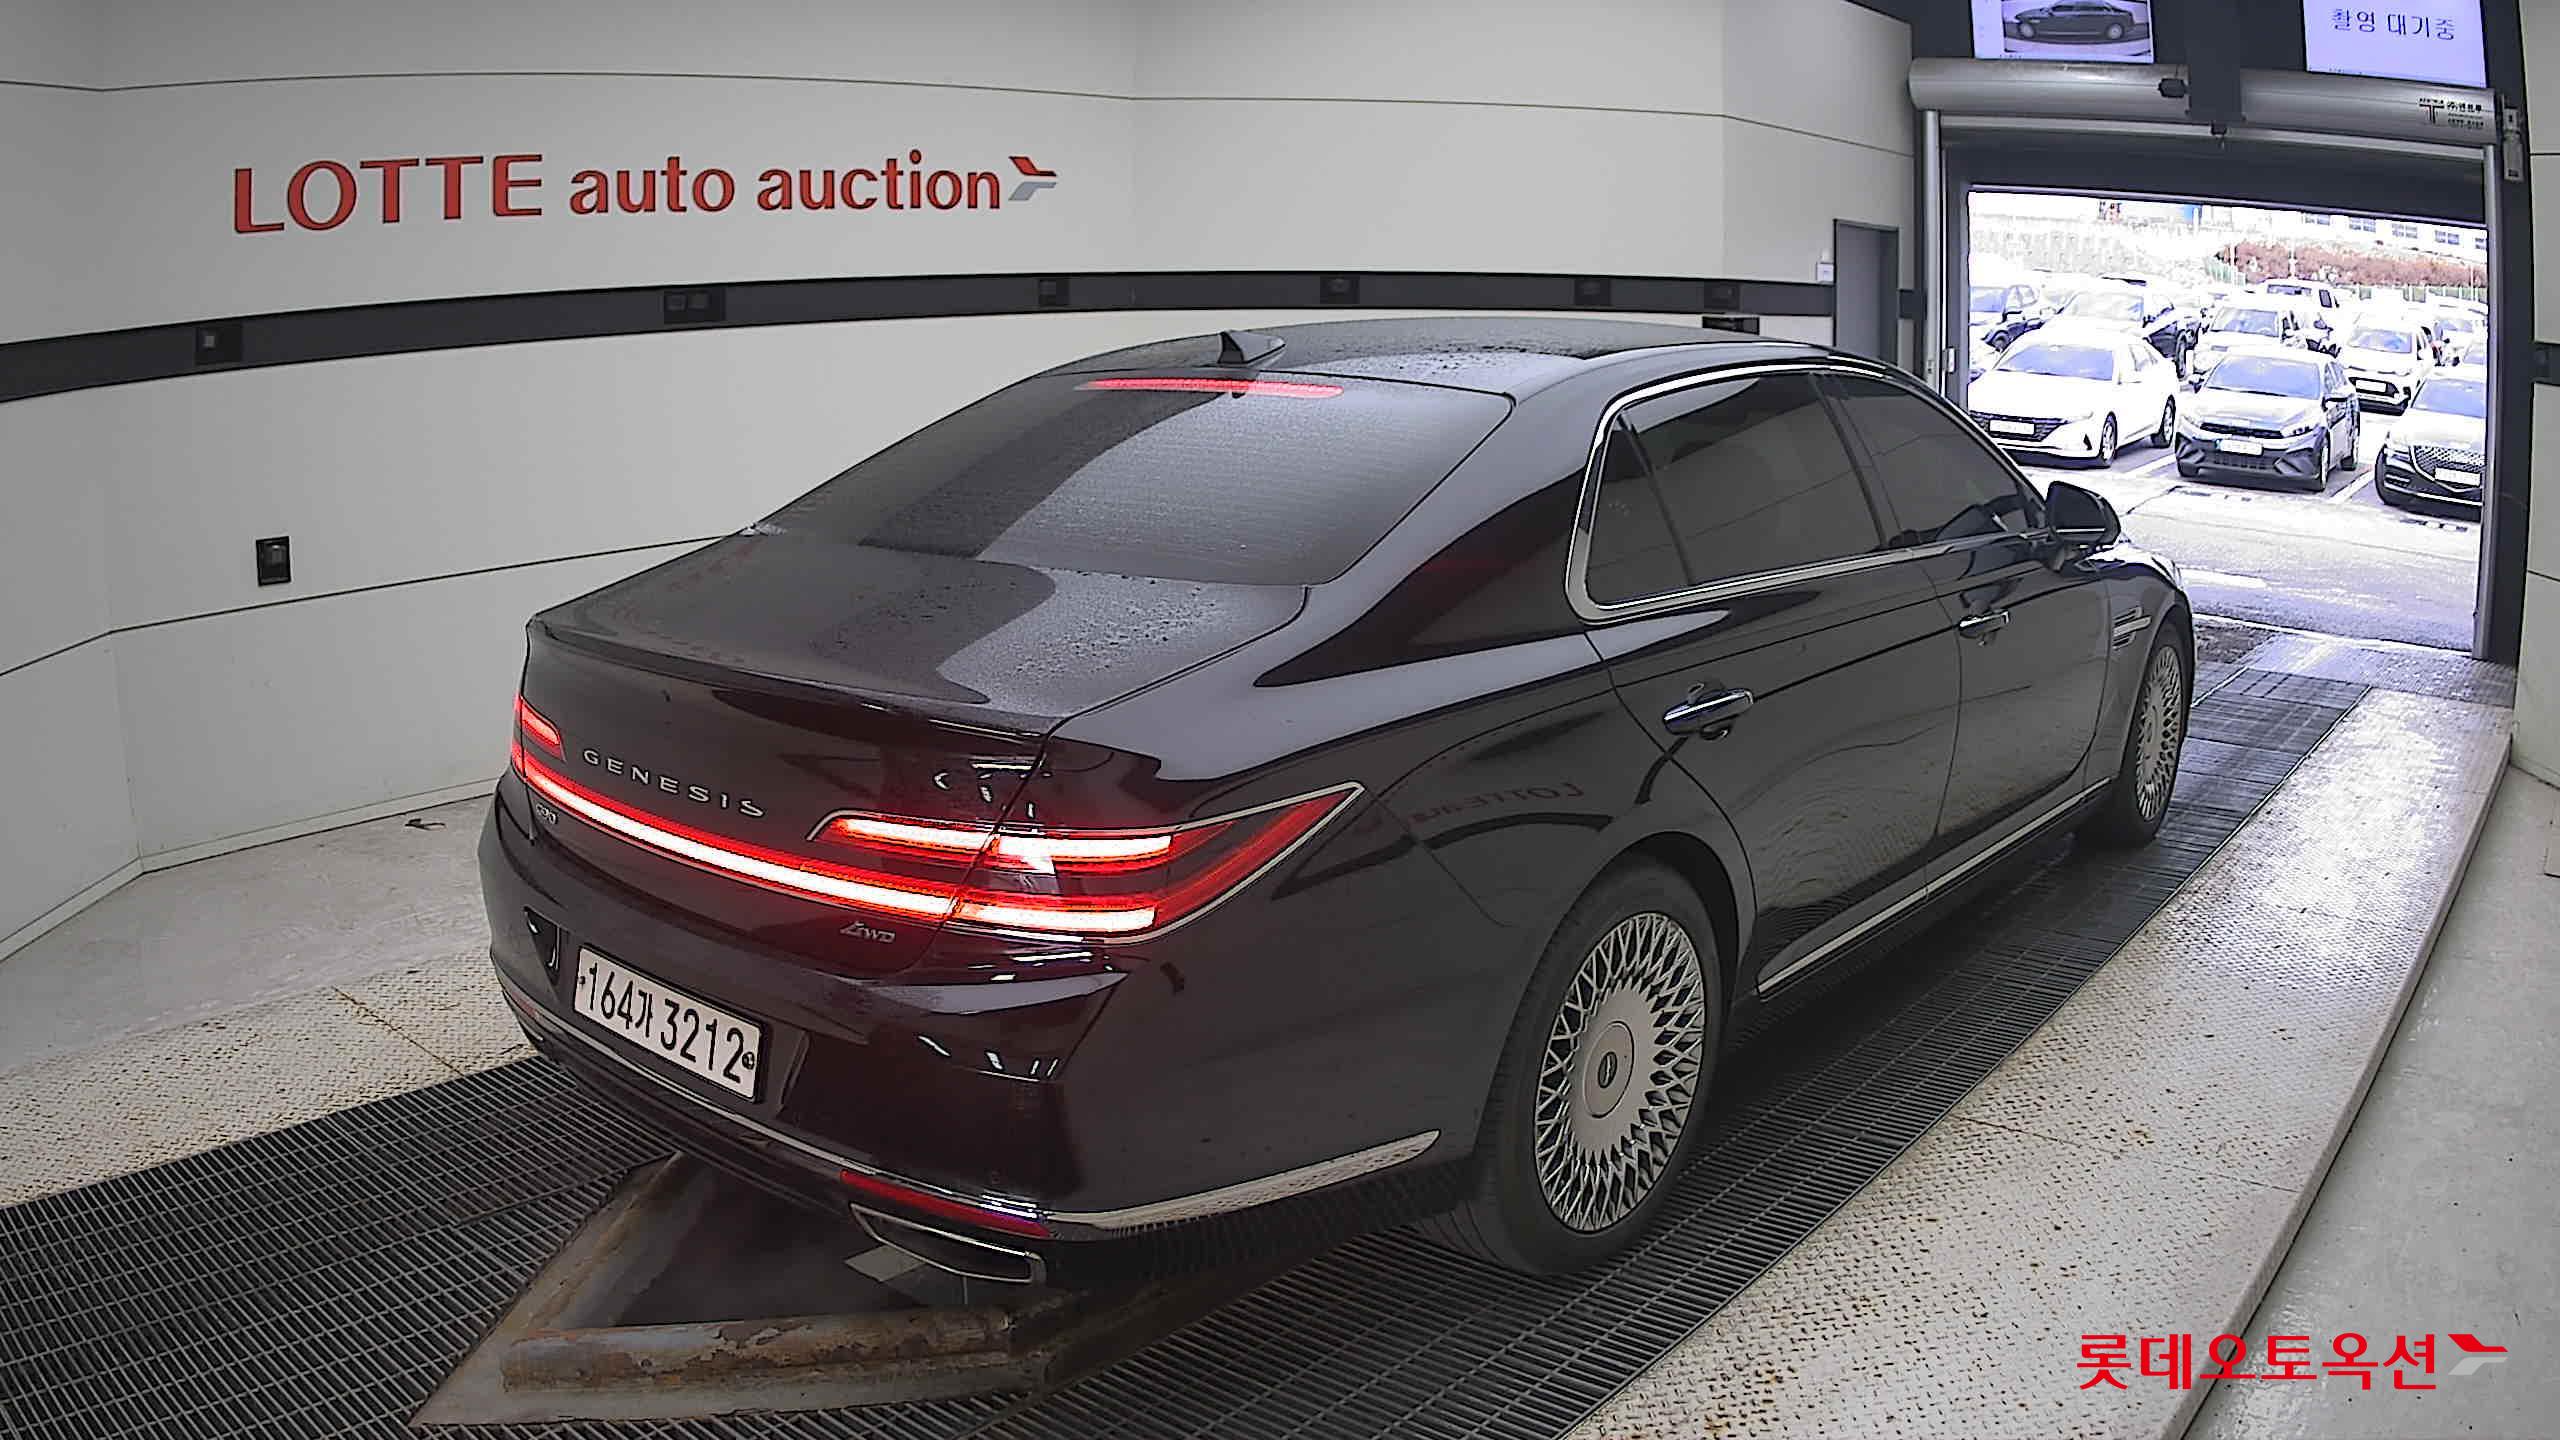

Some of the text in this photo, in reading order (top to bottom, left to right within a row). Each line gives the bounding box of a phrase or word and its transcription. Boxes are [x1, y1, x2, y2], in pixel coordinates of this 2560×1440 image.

[2331, 8, 2456, 41] 촬영 대기중
[235, 150, 1000, 234] LOTTE auto auction
[583, 748, 766, 818] GENESIS
[660, 997, 742, 1085] 3212
